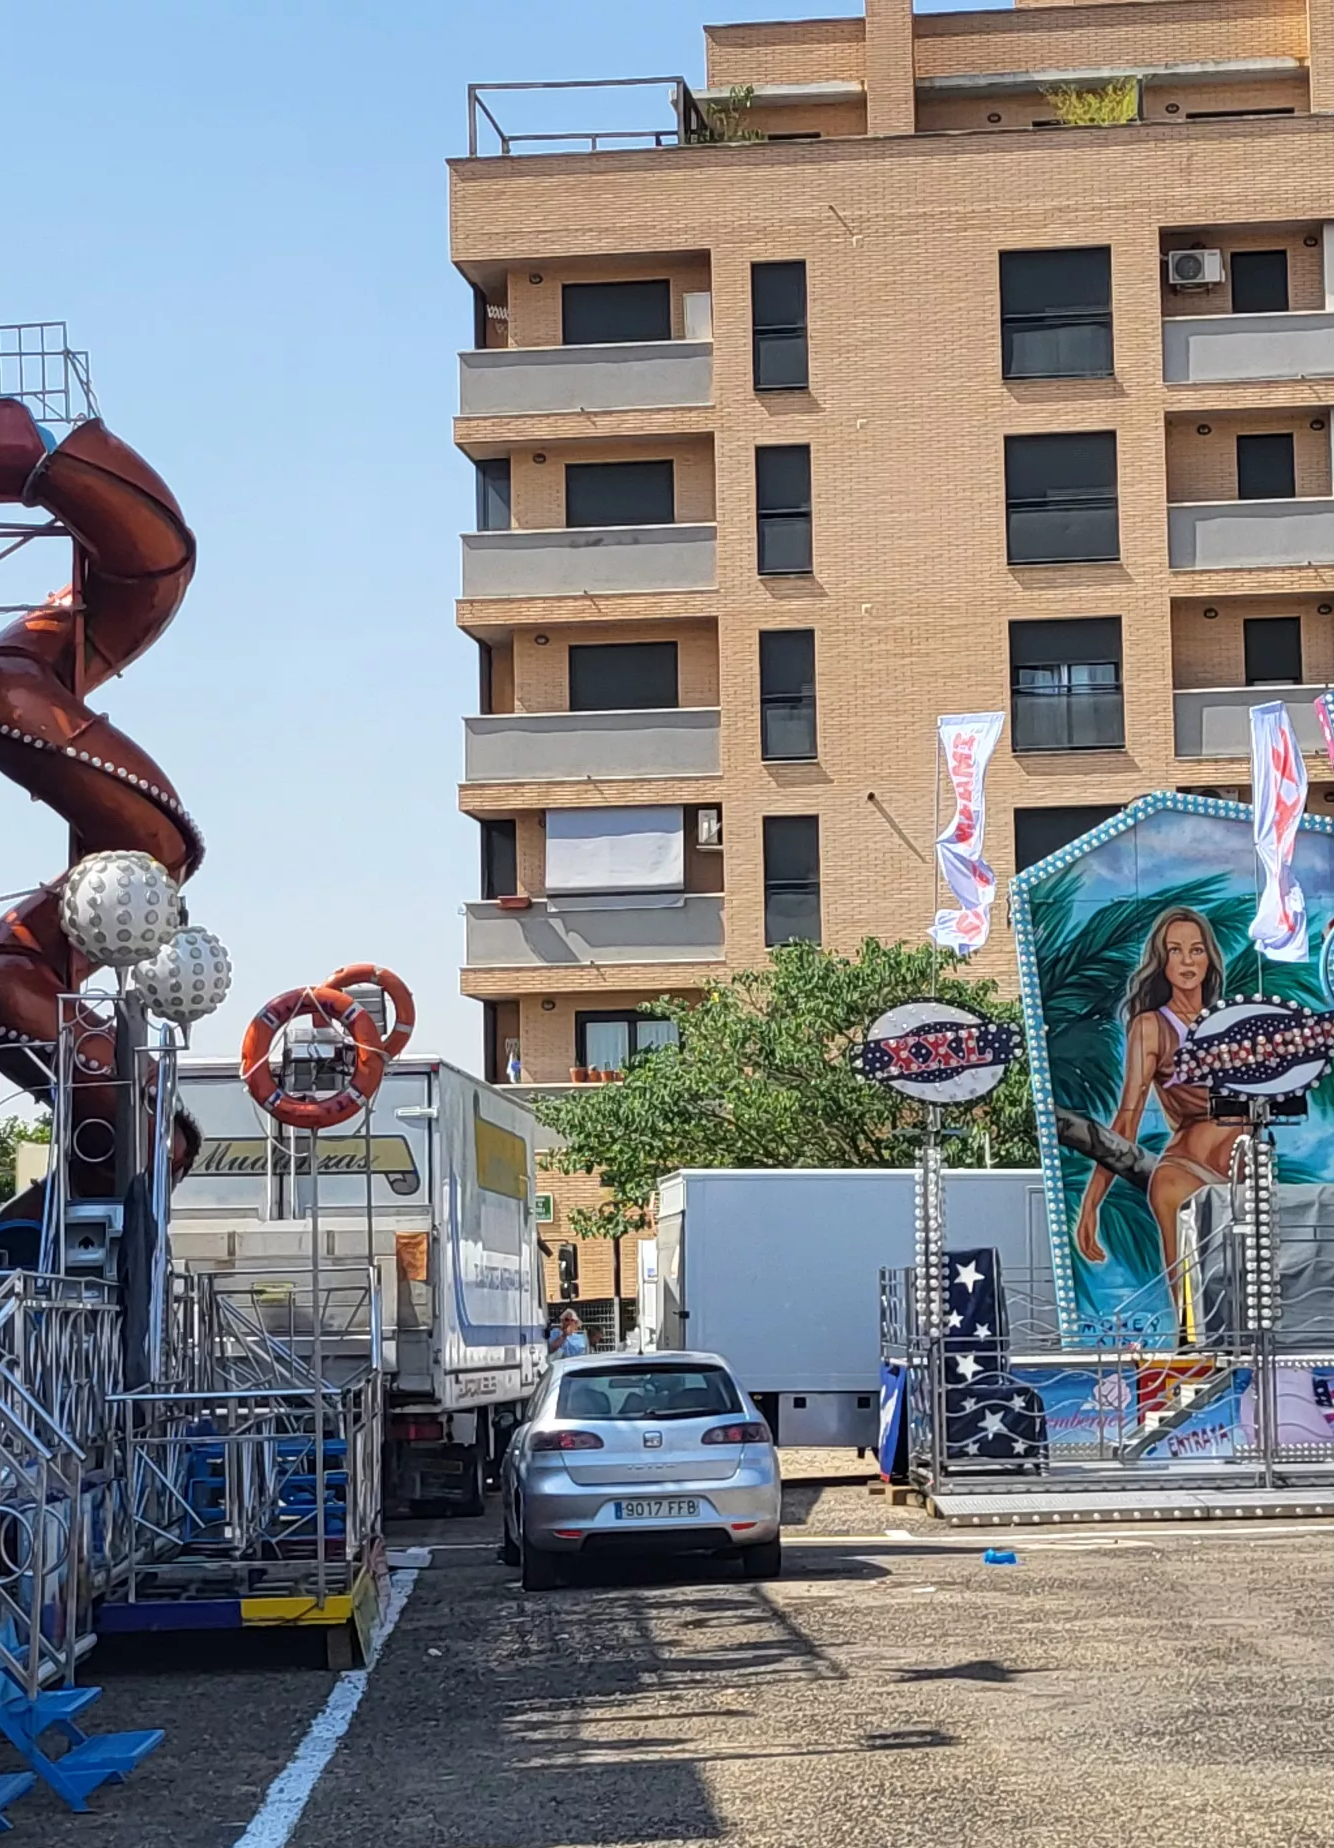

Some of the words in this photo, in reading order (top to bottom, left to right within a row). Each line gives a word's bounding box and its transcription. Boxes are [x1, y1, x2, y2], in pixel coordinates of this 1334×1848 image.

[880, 1026, 994, 1076] XXL
[626, 1501, 663, 1517] 9017
[668, 1500, 697, 1515] FFB
